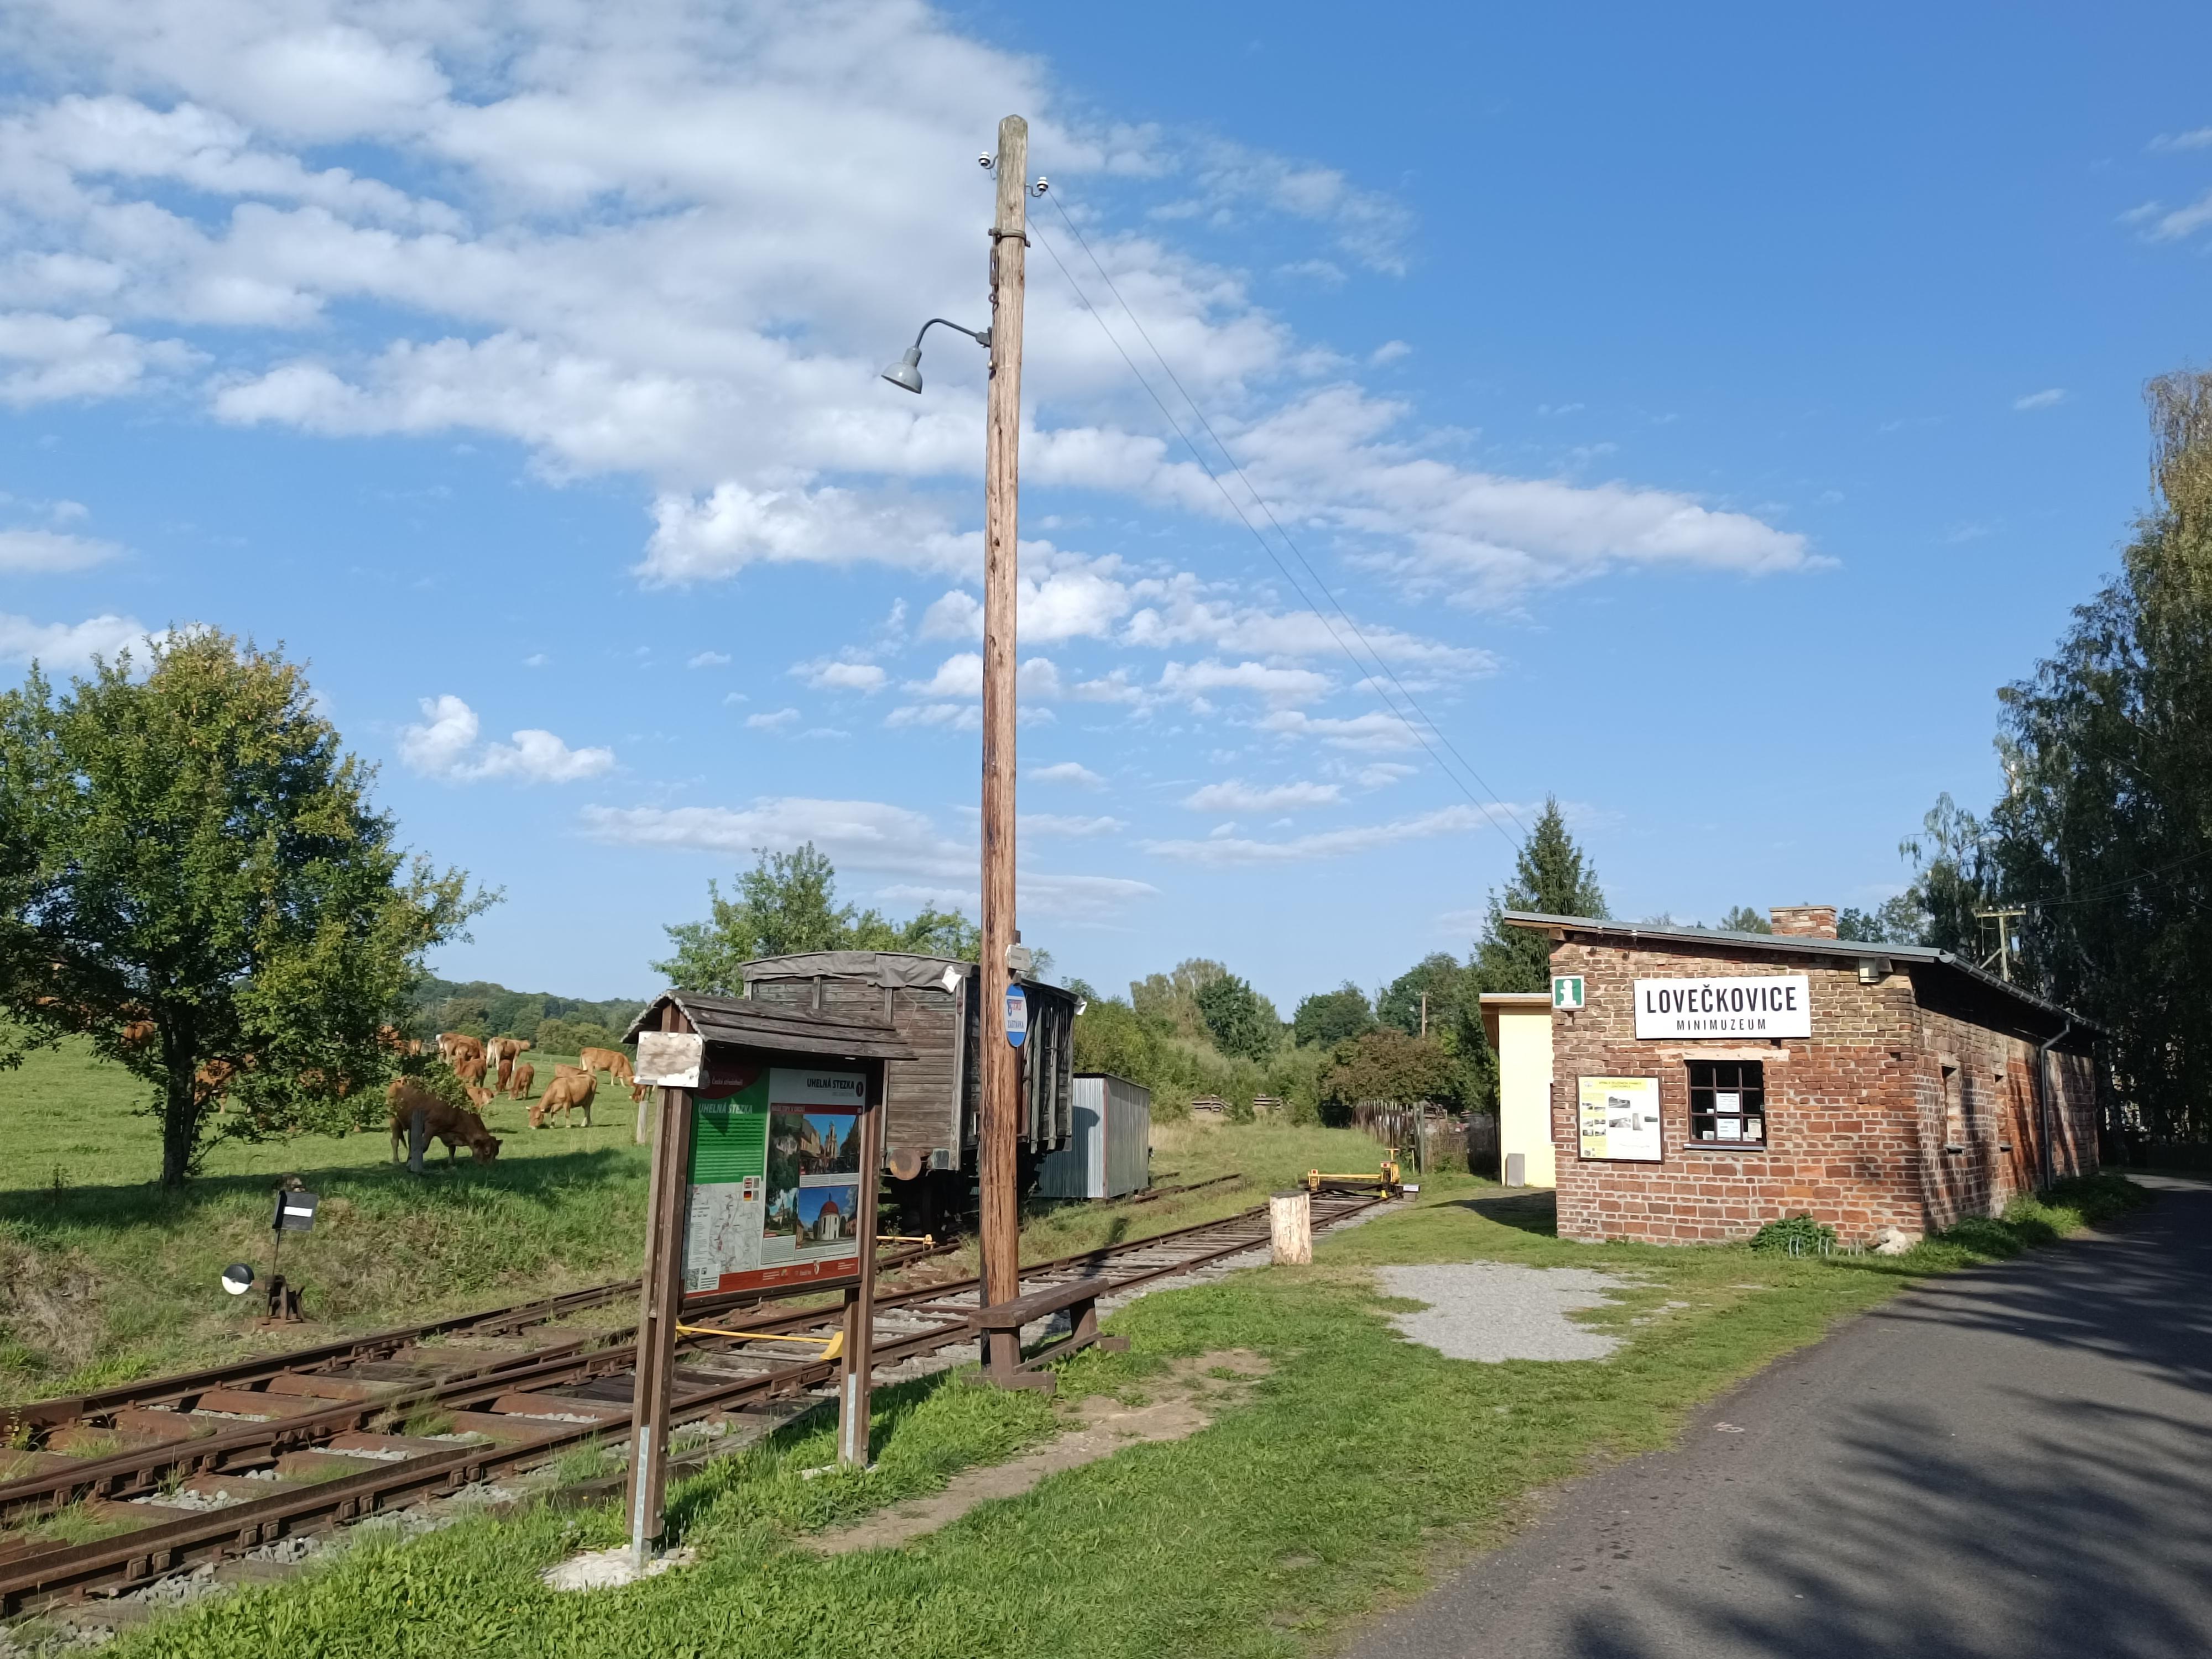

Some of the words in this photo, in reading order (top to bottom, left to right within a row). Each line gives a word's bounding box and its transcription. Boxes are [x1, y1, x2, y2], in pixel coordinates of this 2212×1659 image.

[1647, 984, 1797, 1014] LOVEČKOVICE
[1677, 1019, 1766, 1031] MINIMUZEUM
[807, 1077, 831, 1088] UHELNÁ
[832, 1079, 855, 1089] STEZKA
[698, 1102, 727, 1114] UHELNÁ
[728, 1104, 753, 1114] STEZKA
